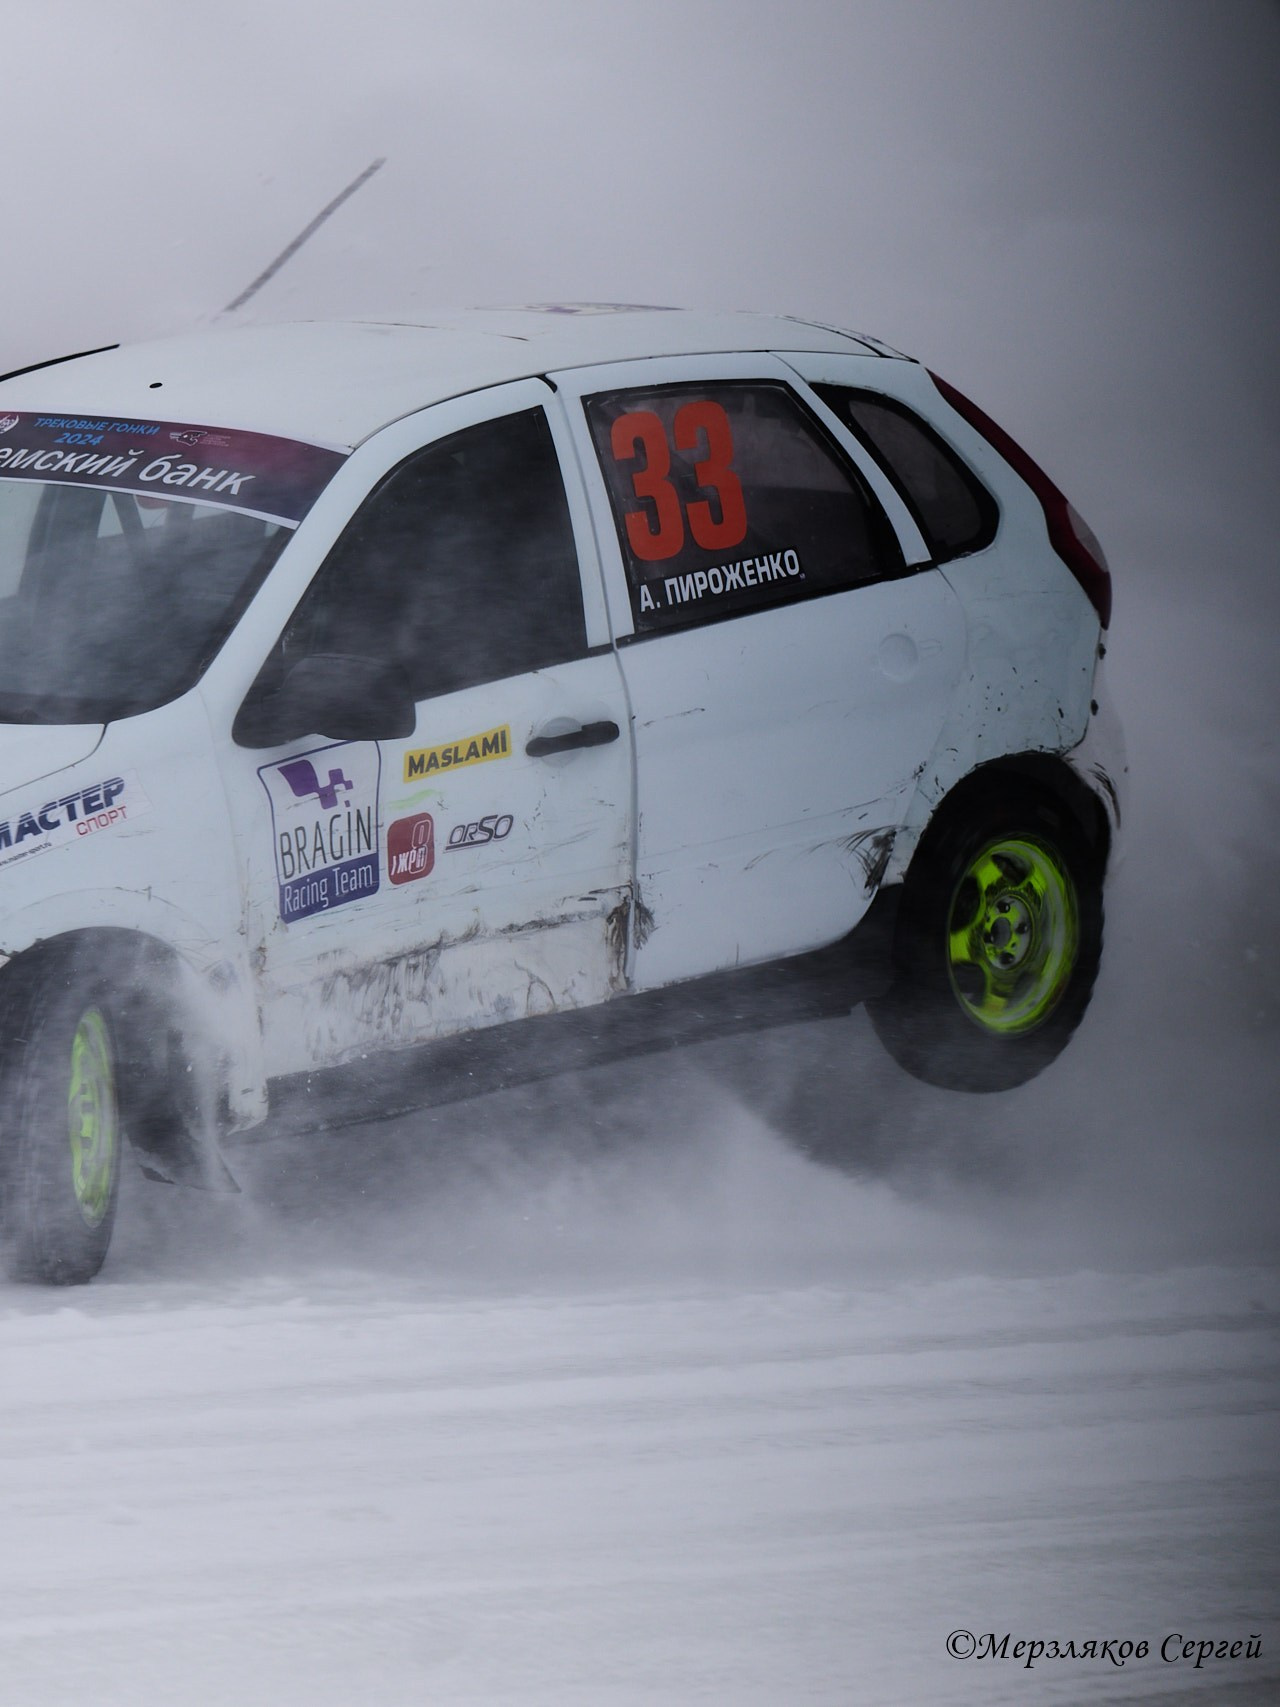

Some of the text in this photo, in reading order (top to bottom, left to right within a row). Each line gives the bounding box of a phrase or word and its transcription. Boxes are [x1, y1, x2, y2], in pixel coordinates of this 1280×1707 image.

[34, 417, 161, 436] ТРЕКОВЫЕ ГОНКИ
[54, 432, 104, 446] 2024
[138, 454, 255, 495] банк
[610, 401, 747, 561] 33
[639, 549, 800, 613] А. ПИРОЖЕНКО
[407, 729, 508, 777] MASLAMI
[76, 806, 127, 836] СПОРТ
[284, 863, 374, 914] Racing Team
